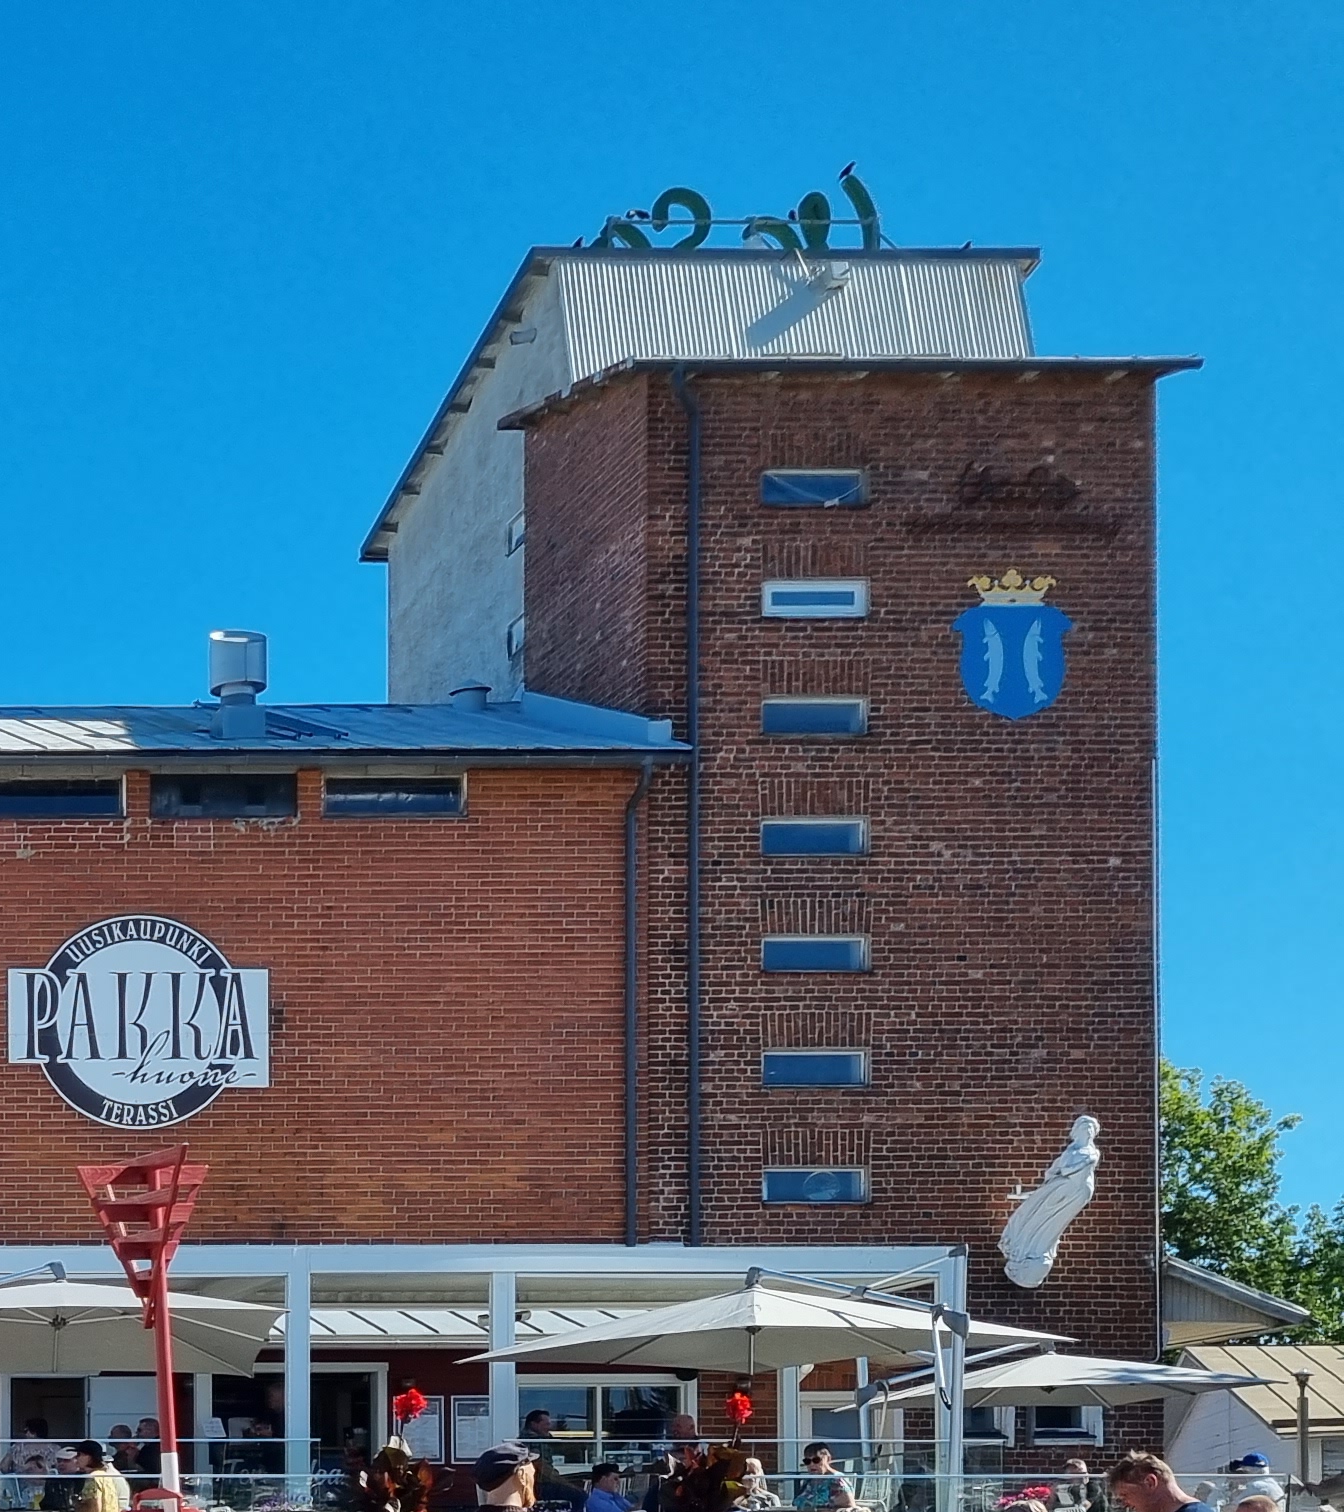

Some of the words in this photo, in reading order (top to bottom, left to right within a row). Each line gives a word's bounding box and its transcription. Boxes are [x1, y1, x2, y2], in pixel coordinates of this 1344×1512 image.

[63, 919, 214, 966] UUSIKAUPUNKI
[16, 970, 260, 1063] PAKKA
[99, 1098, 179, 1126] TERASSI
